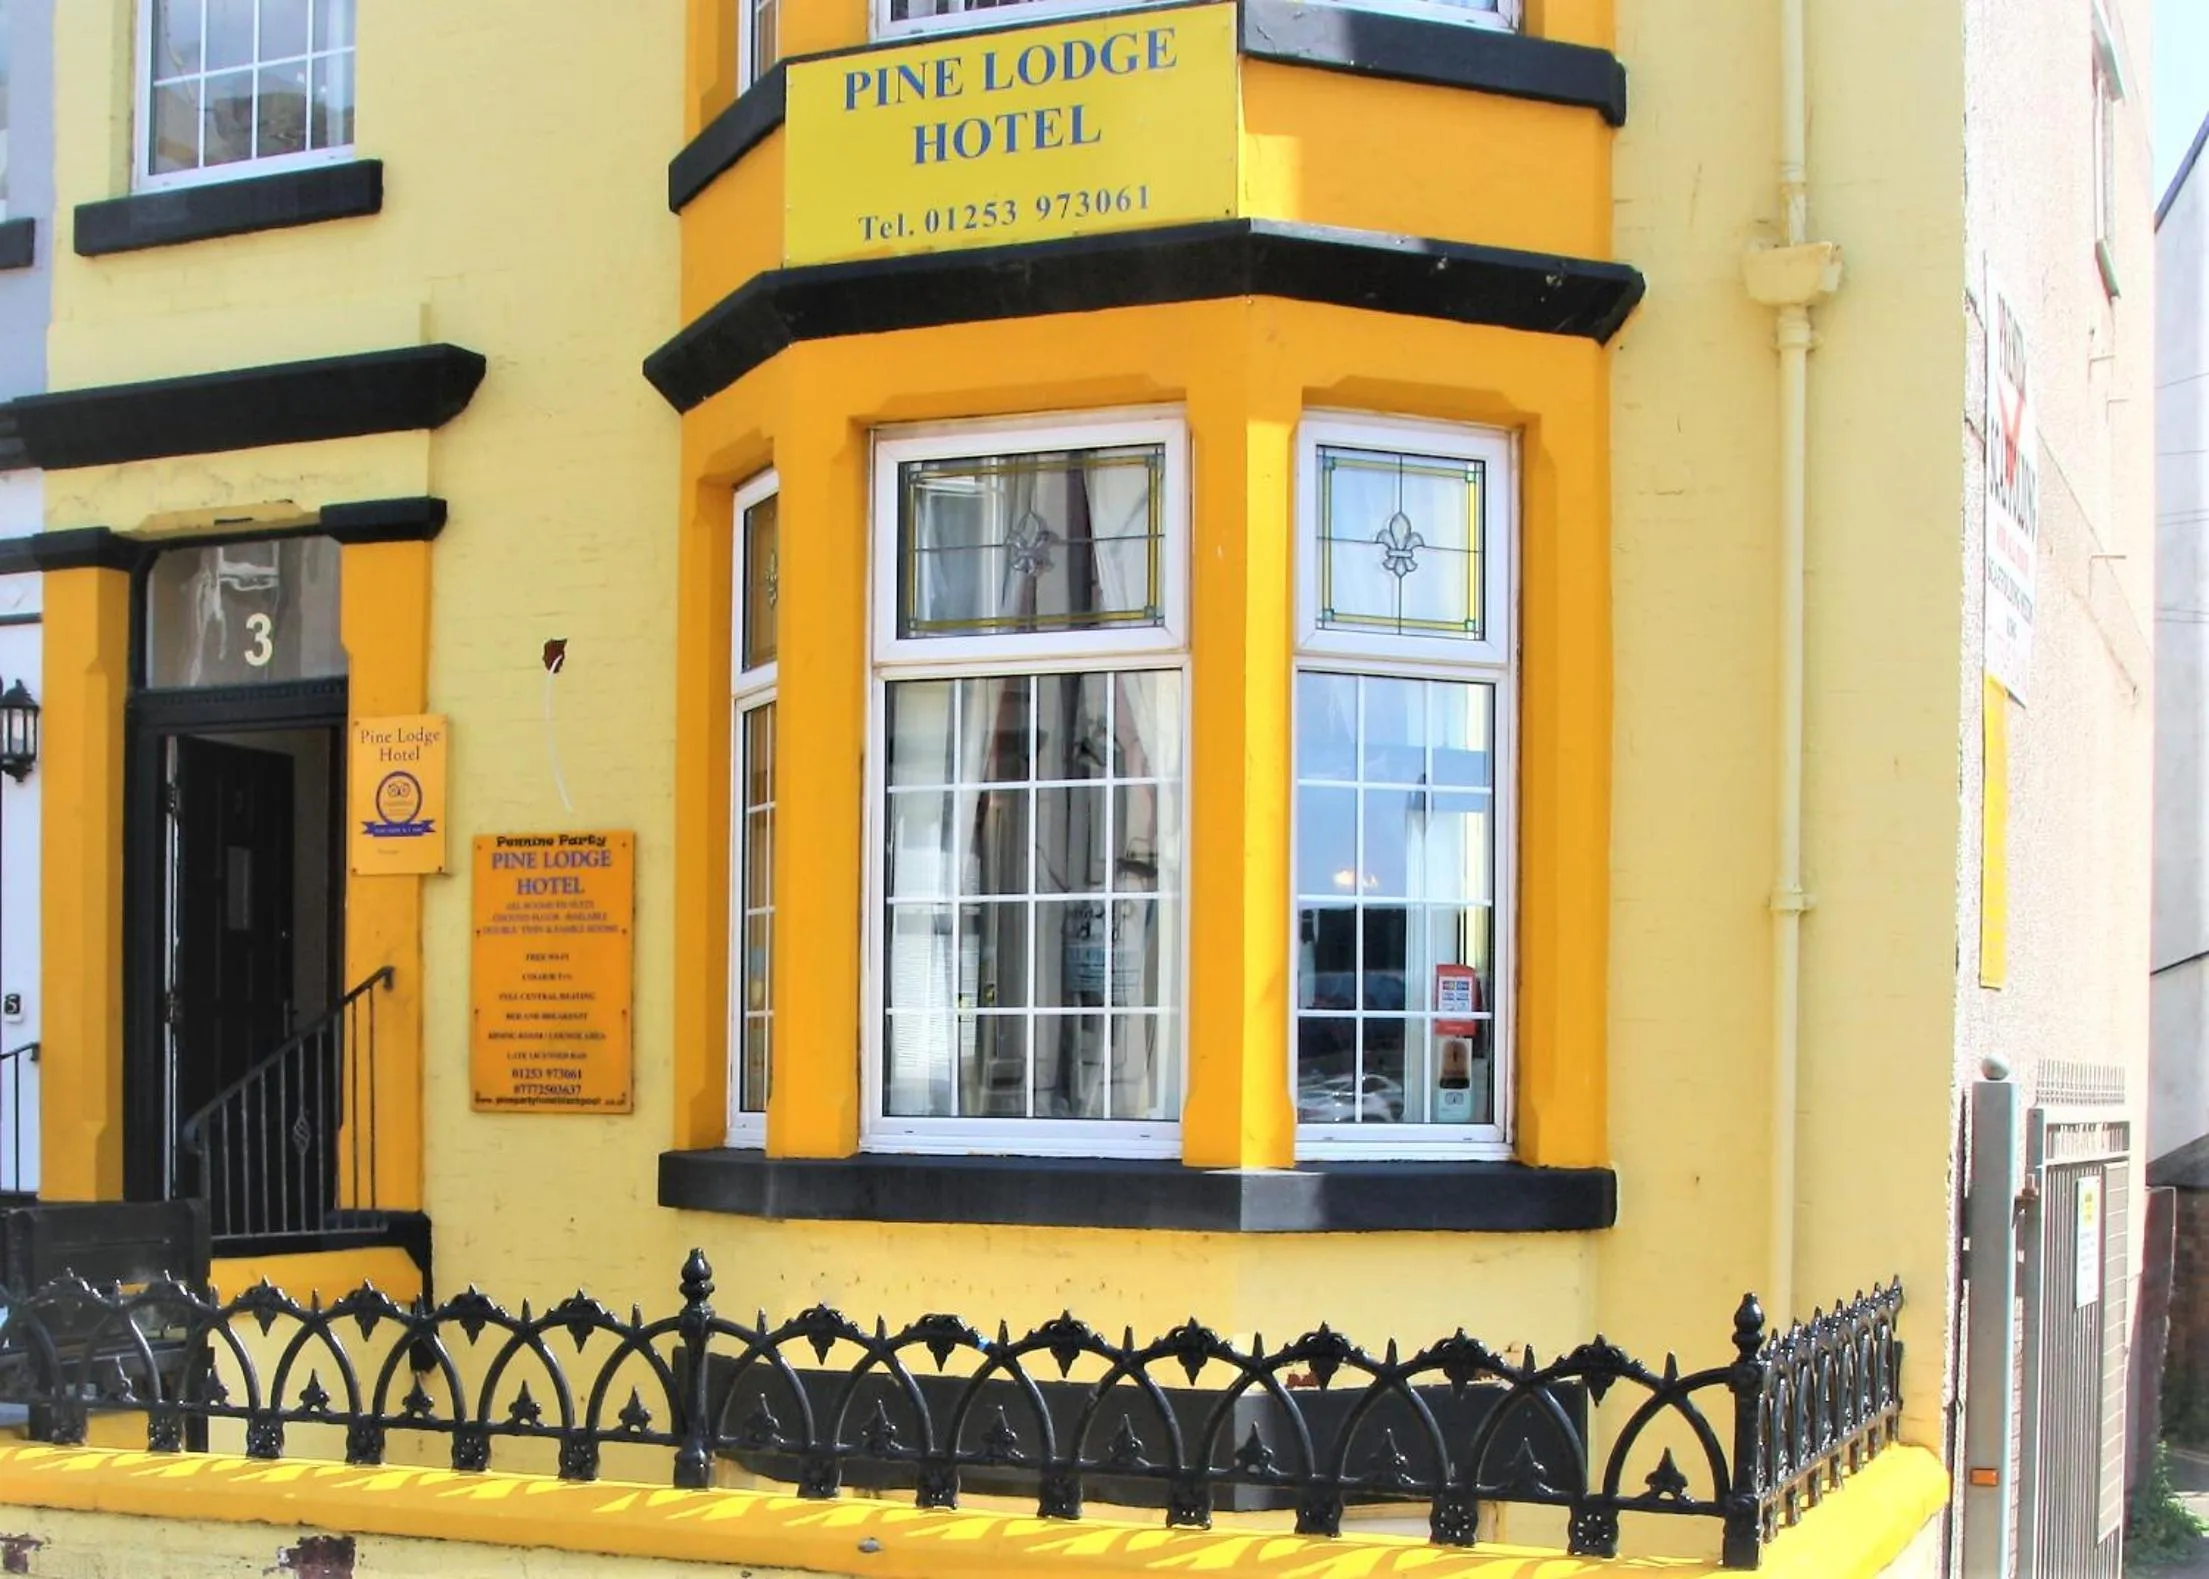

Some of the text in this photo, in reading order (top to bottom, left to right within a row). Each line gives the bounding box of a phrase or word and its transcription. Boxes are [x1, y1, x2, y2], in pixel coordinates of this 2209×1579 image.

[843, 28, 1178, 111] PINE LODGE
[913, 104, 1102, 165] HOTEL
[858, 185, 1151, 241] Tel. 01253 973061
[244, 612, 273, 667] 3
[361, 727, 440, 746] Pine Lodge
[379, 746, 421, 762] Hotel
[559, 834, 607, 847] Party
[491, 849, 612, 870] PINE LODGE
[516, 876, 585, 896] HOTEL
[511, 1067, 582, 1079] 01253 973061
